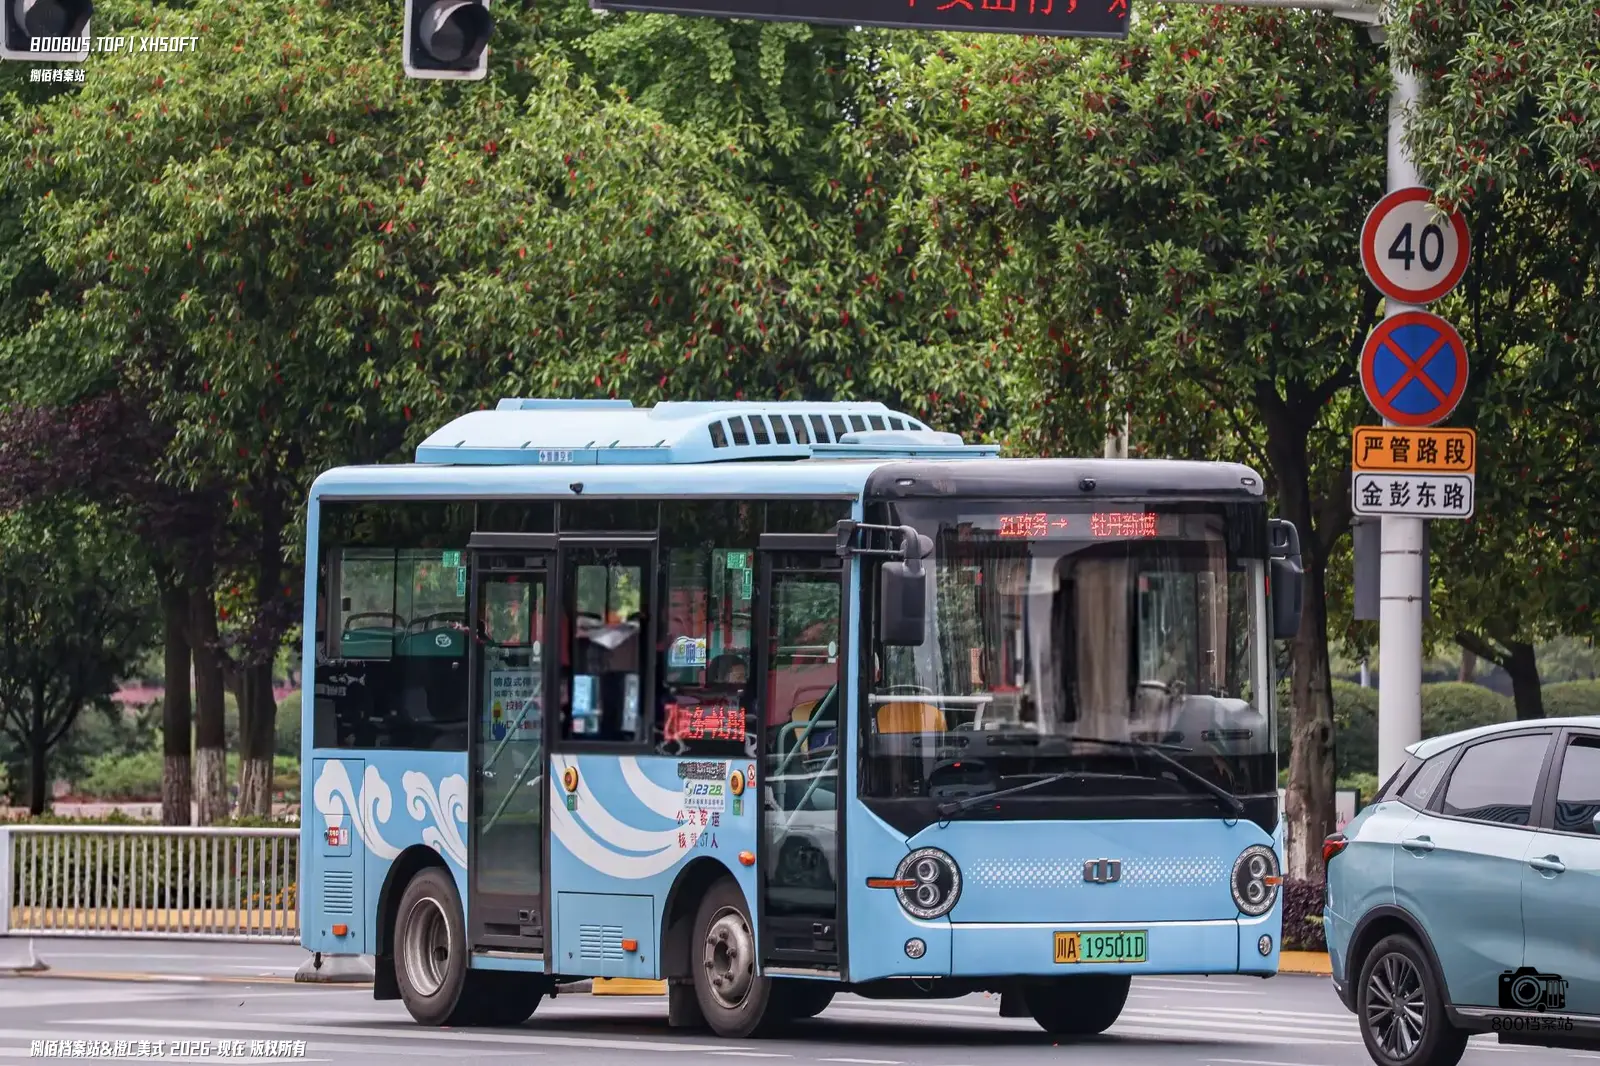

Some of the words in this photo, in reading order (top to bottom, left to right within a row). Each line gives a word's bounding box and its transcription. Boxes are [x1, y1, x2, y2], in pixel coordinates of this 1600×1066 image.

[1388, 222, 1444, 272] 40
[1362, 436, 1466, 465] 严管路段
[1361, 480, 1465, 509] 金彭东路
[676, 809, 720, 827] 公交客运
[1057, 938, 1077, 959] 川A
[1086, 936, 1144, 958] 19501D
